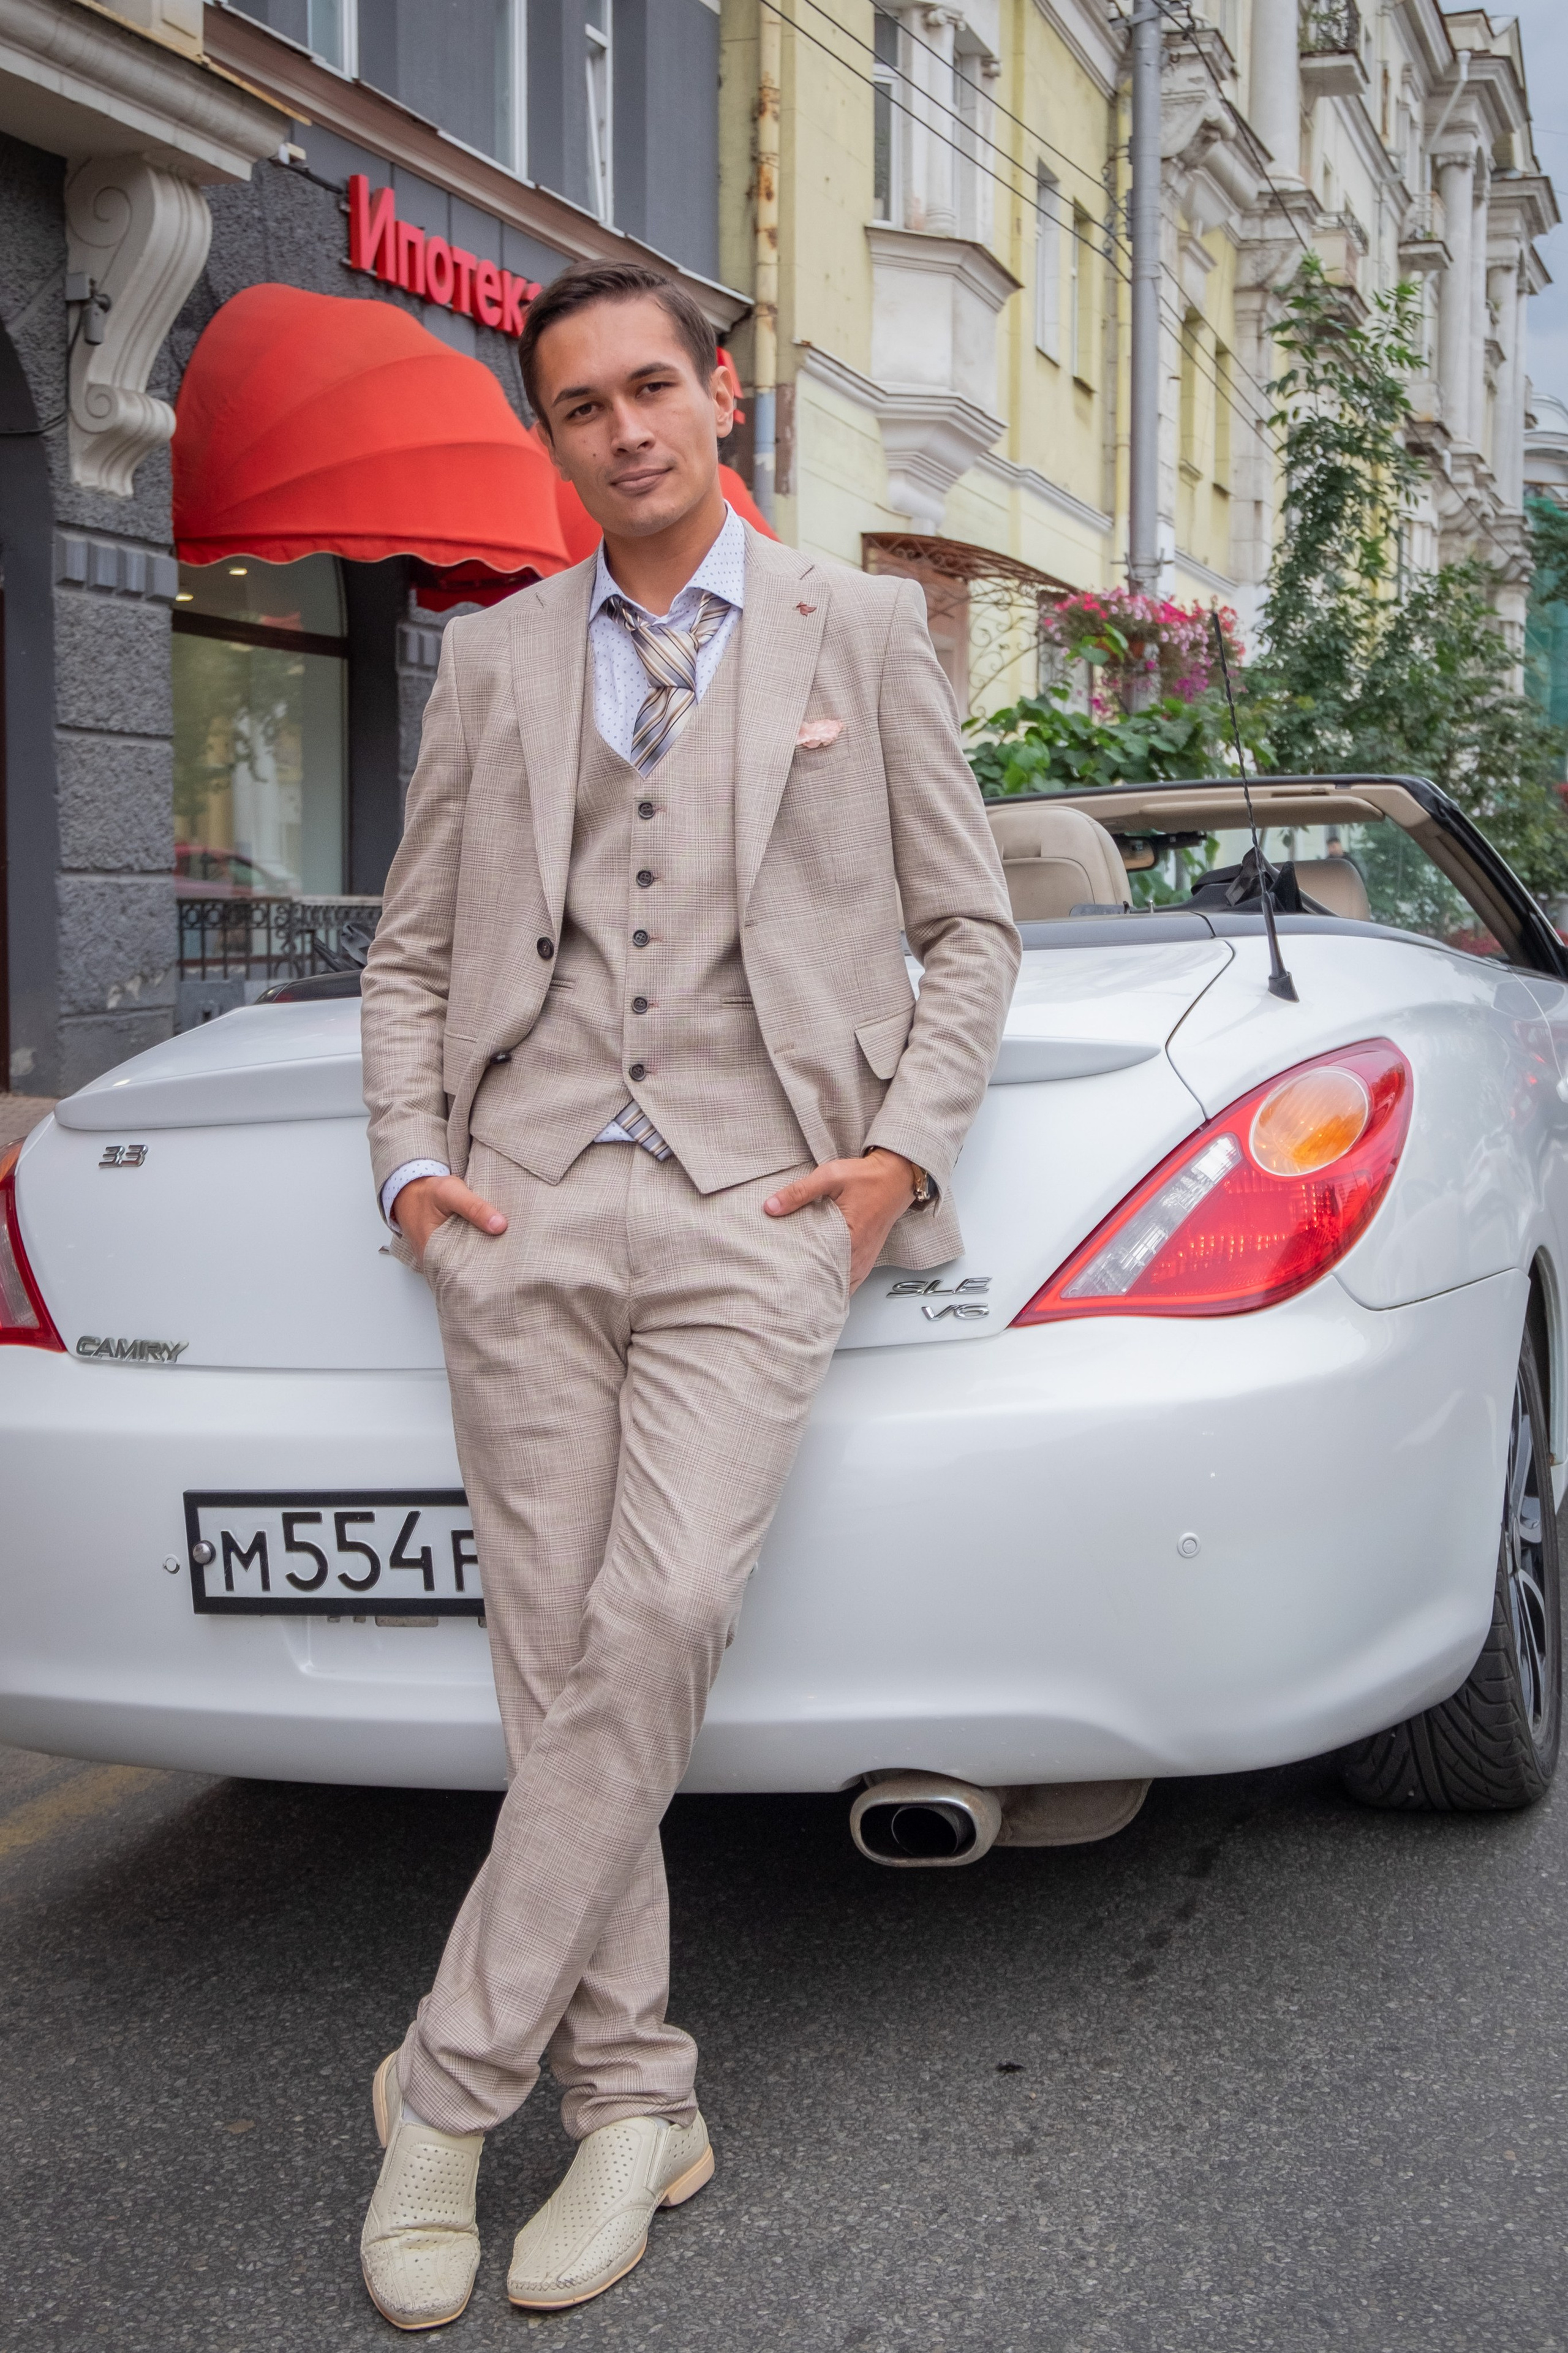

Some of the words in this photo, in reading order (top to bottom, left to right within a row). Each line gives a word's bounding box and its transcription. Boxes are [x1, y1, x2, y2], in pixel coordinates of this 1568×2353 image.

[349, 174, 543, 338] Ипотек
[98, 1144, 148, 1168] 33
[886, 1277, 992, 1299] SLE
[921, 1302, 990, 1321] V6
[76, 1335, 189, 1363] CAMRY
